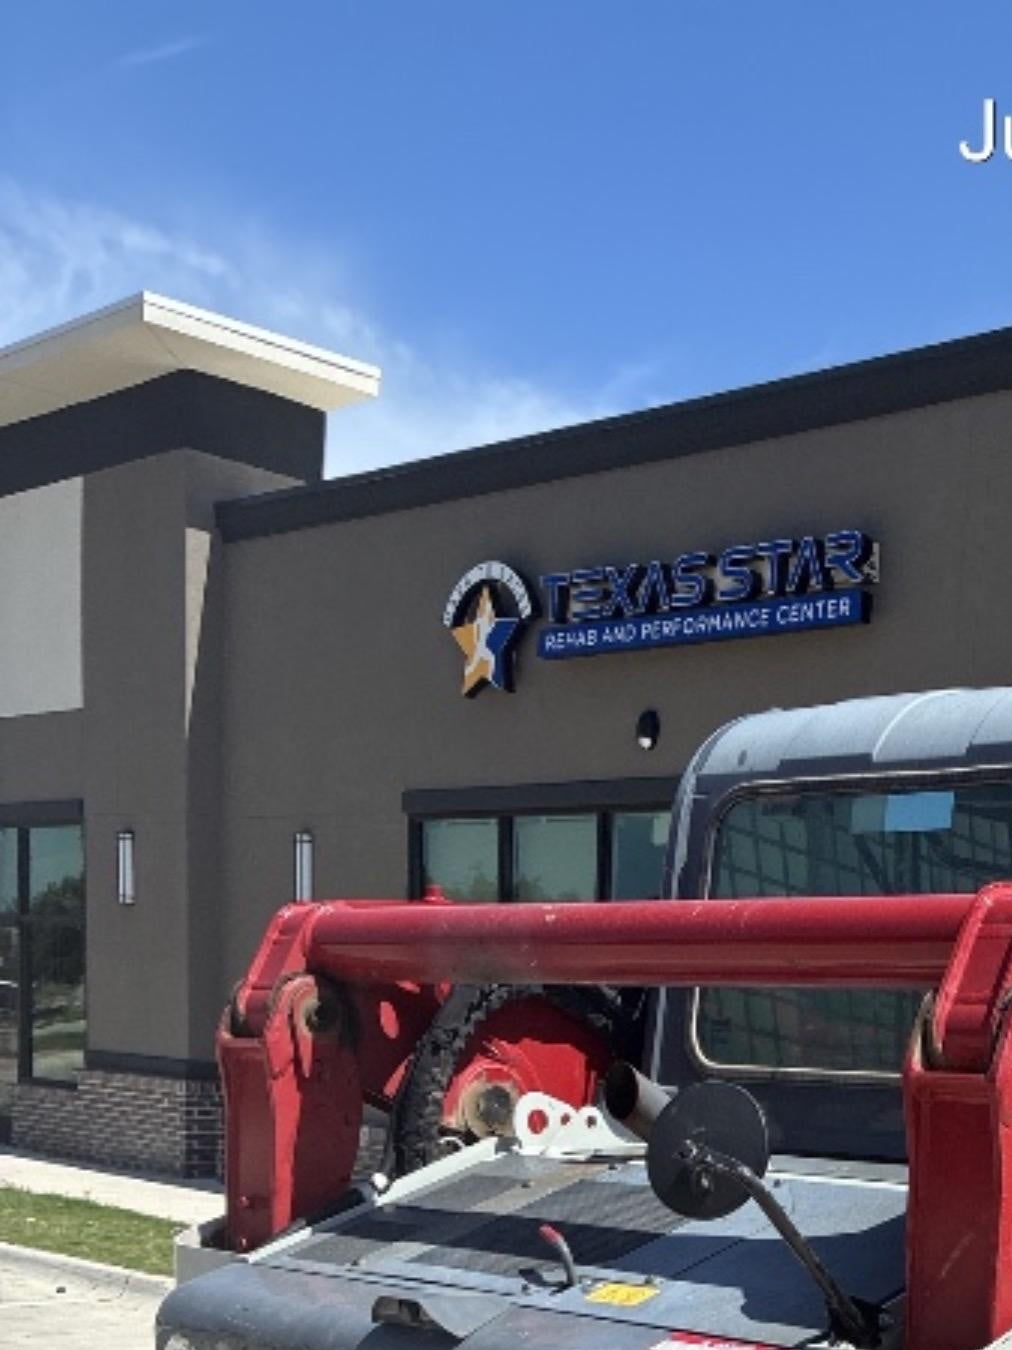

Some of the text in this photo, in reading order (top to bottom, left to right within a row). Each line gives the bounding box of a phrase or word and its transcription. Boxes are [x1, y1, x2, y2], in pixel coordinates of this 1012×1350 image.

[540, 552, 711, 623] TEXAS
[717, 530, 865, 601] STAR
[545, 597, 851, 650] REHAB AND PERFORMANCE CENTER
